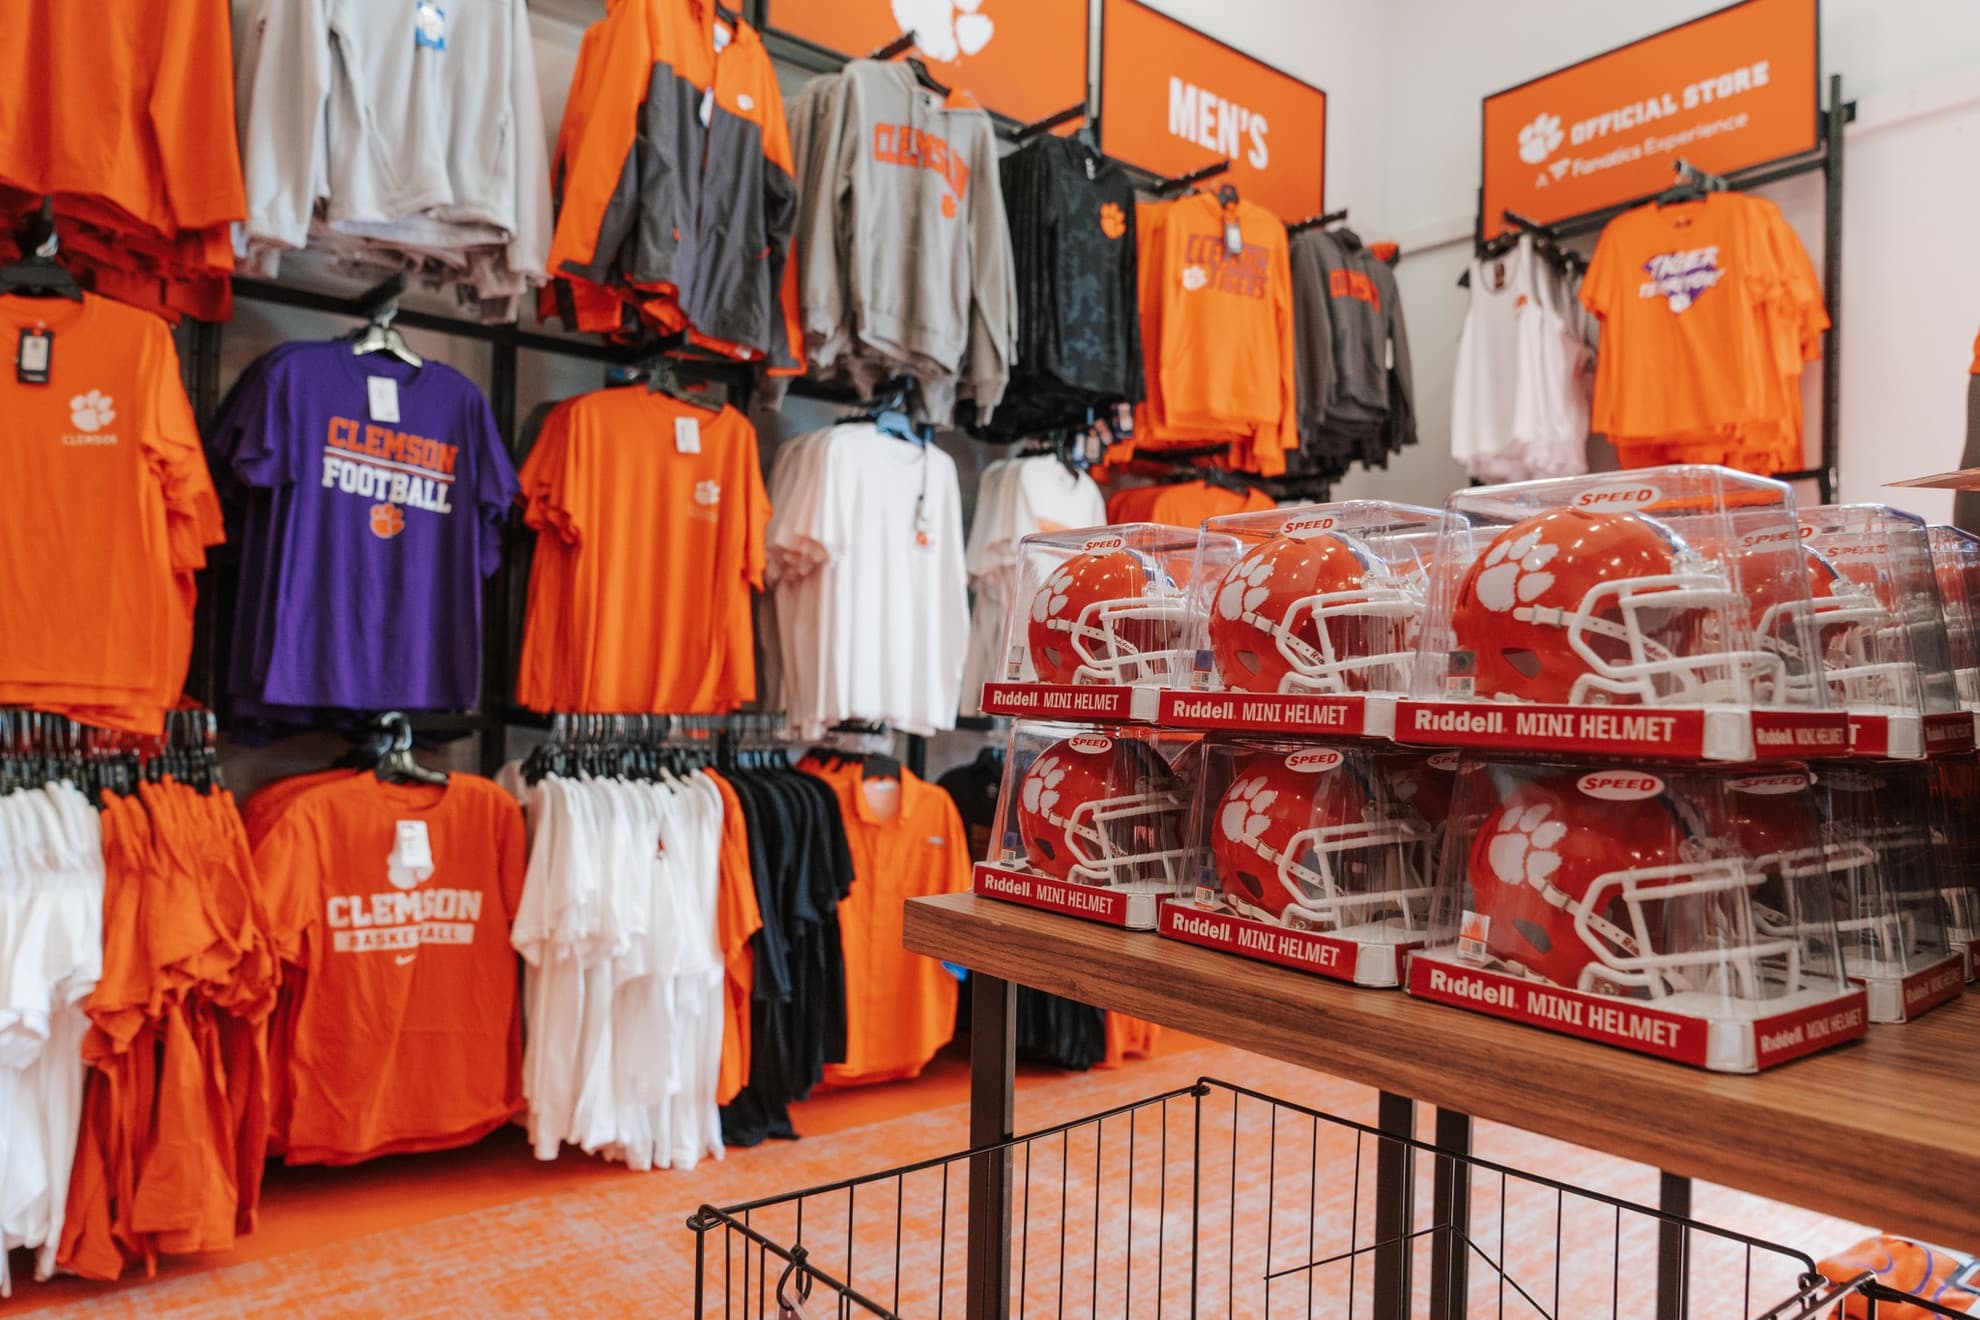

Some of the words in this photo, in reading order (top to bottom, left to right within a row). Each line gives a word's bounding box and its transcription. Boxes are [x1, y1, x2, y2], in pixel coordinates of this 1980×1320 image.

[1570, 94, 1678, 145] OFFICIAL
[1683, 60, 1769, 110] STORE
[1169, 76, 1268, 170] MEN'S
[1535, 172, 1549, 190] A
[1571, 145, 1643, 177] Fanatics
[1643, 113, 1748, 160] Experience
[327, 416, 459, 473] CLEMSON
[321, 455, 453, 514] FOOTBALL
[1577, 489, 1653, 506] SPEED
[1284, 518, 1334, 533] SPEED
[1084, 538, 1121, 551] SPEED
[993, 690, 1037, 706] Riddell
[1043, 691, 1073, 708] MINI
[1074, 693, 1119, 711] HELMET
[1173, 699, 1233, 720] Riddell
[1242, 702, 1283, 723] MINI
[1285, 705, 1348, 726] HELMET
[1071, 736, 1109, 749] SPEED
[1415, 709, 1502, 733] Riddell
[1516, 712, 1574, 737] MINI
[1580, 714, 1677, 742] HELMET
[1289, 751, 1339, 766] SPEED
[1582, 777, 1656, 792] SPEED
[327, 888, 483, 928] CLEMSON
[985, 873, 1030, 897] Riddell
[1036, 883, 1067, 906] MINI
[1067, 893, 1114, 916] HELMET
[1173, 912, 1231, 942] Riddell
[1238, 926, 1275, 953] MINI
[1278, 938, 1340, 968] HELMET
[1430, 969, 1515, 1009] Riddell
[1527, 990, 1583, 1026] MINI
[1588, 1004, 1682, 1048] HELMET
